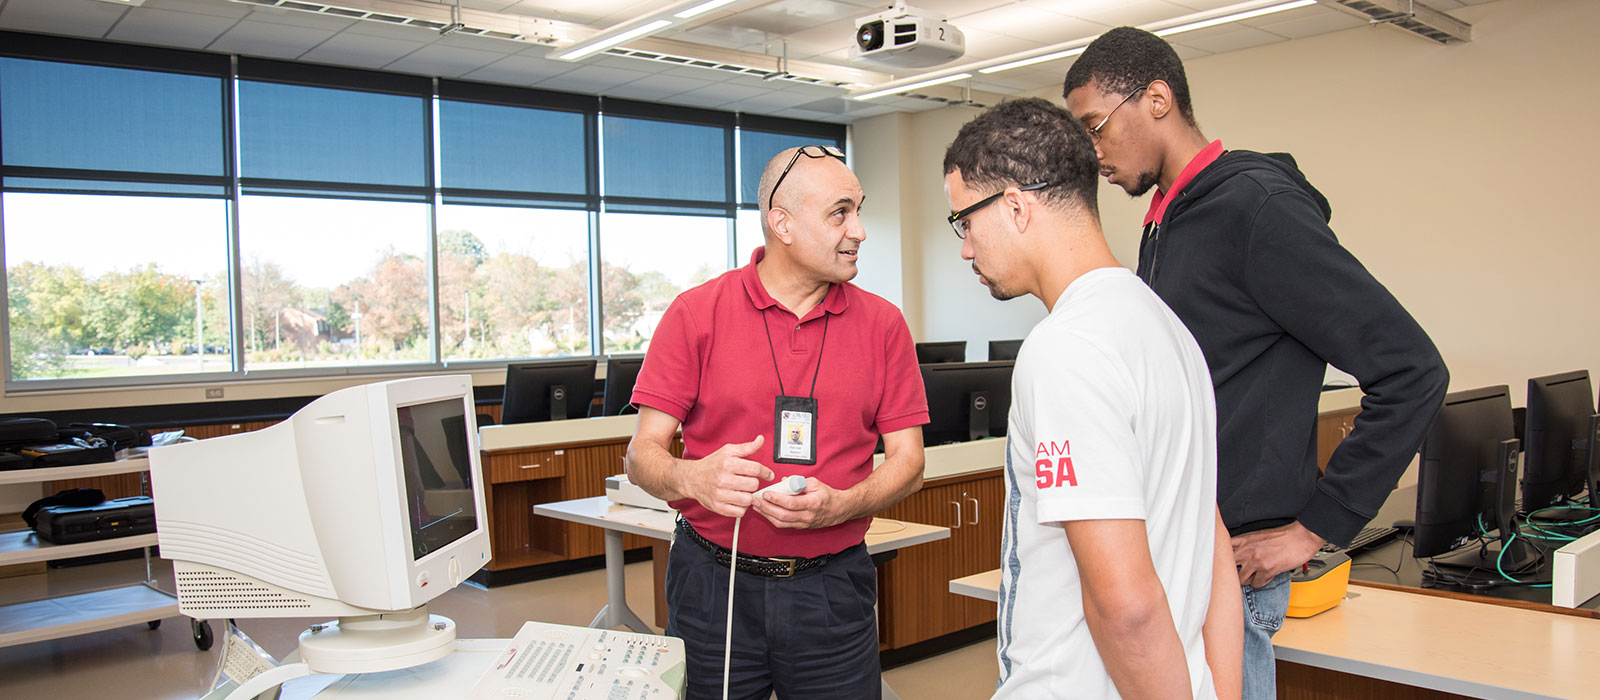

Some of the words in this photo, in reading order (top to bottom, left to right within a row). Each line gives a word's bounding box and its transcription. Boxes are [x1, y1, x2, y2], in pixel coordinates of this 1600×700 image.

[938, 27, 945, 41] 2
[1036, 440, 1070, 457] AM
[1036, 457, 1078, 489] SA
